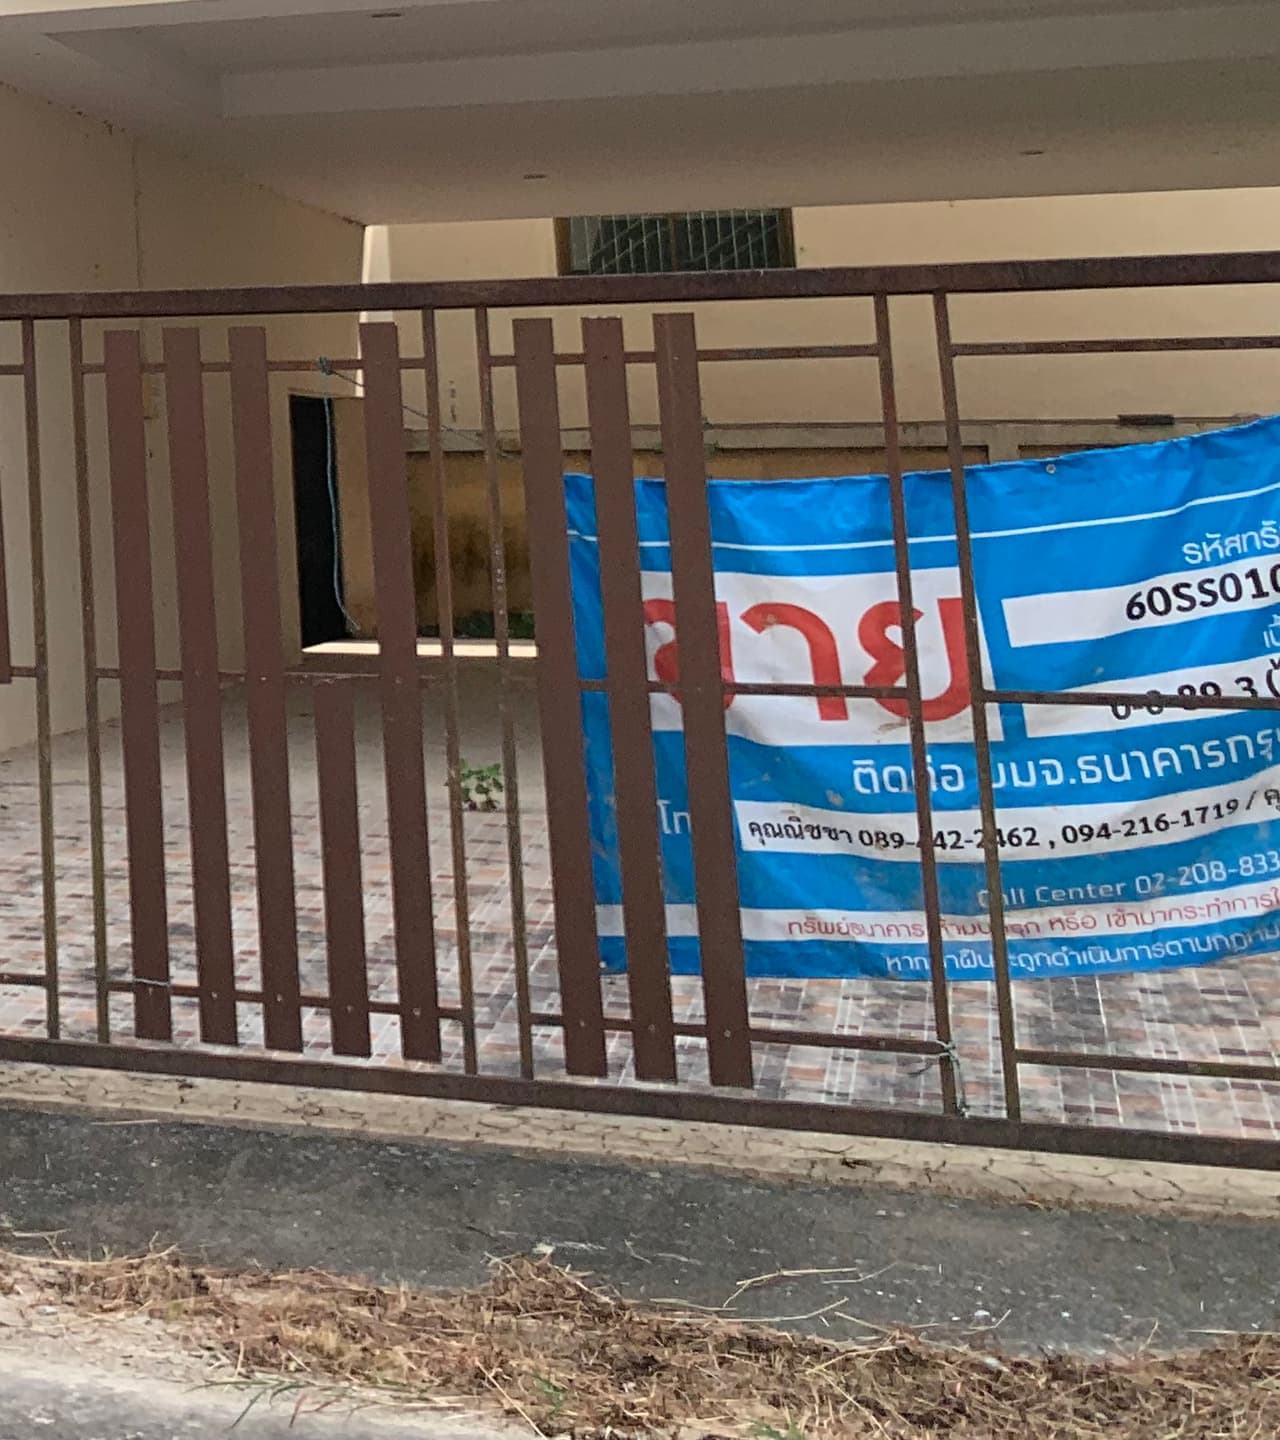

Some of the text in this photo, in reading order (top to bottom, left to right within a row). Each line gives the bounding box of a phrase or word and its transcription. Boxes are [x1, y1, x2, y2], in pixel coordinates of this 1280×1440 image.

[1182, 520, 1280, 565] รหัสทรั
[859, 826, 1040, 850] 089-42-2462
[1061, 798, 1239, 845] 094-216-1719
[1035, 881, 1127, 903] Center
